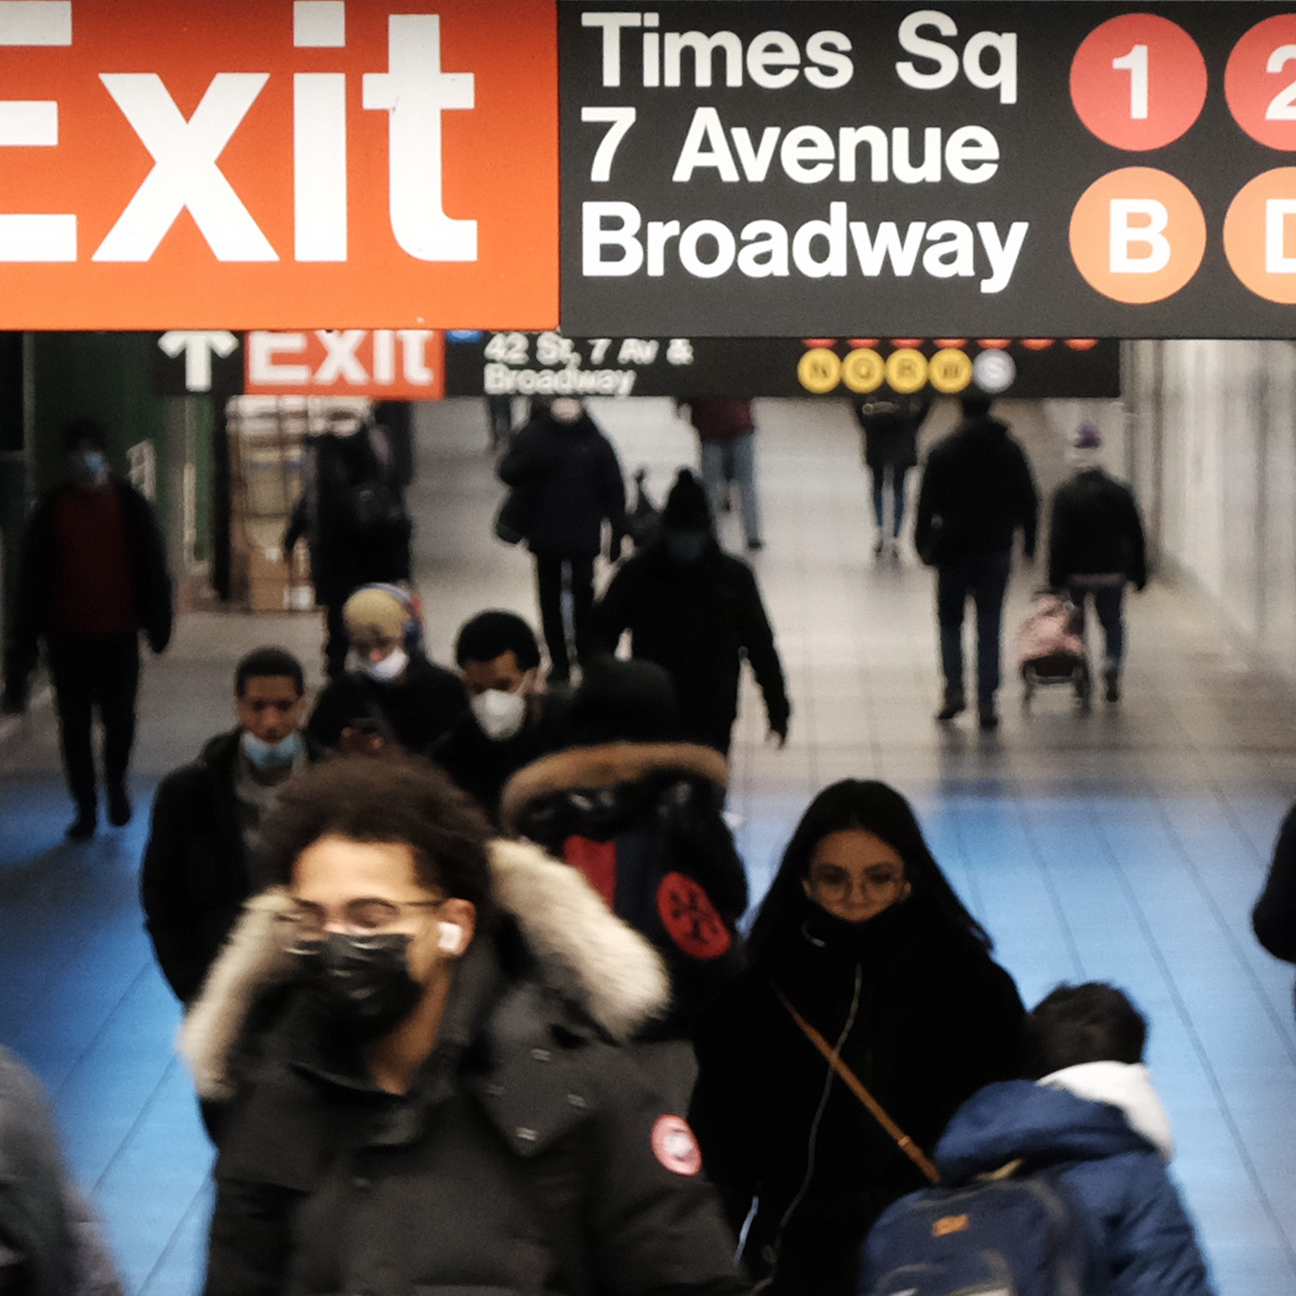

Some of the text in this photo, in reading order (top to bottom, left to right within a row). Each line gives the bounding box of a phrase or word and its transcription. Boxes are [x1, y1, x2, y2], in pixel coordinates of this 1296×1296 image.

[581, 10, 1018, 105] Times Sq
[1112, 45, 1149, 120] 1
[580, 106, 1000, 185] 7 Avenue
[581, 200, 1030, 294] Broadway
[1108, 198, 1172, 275] B
[483, 332, 530, 365] 42
[588, 338, 613, 365] 7
[617, 338, 660, 365] Av
[666, 338, 694, 365] &
[483, 363, 638, 397] Broadway
